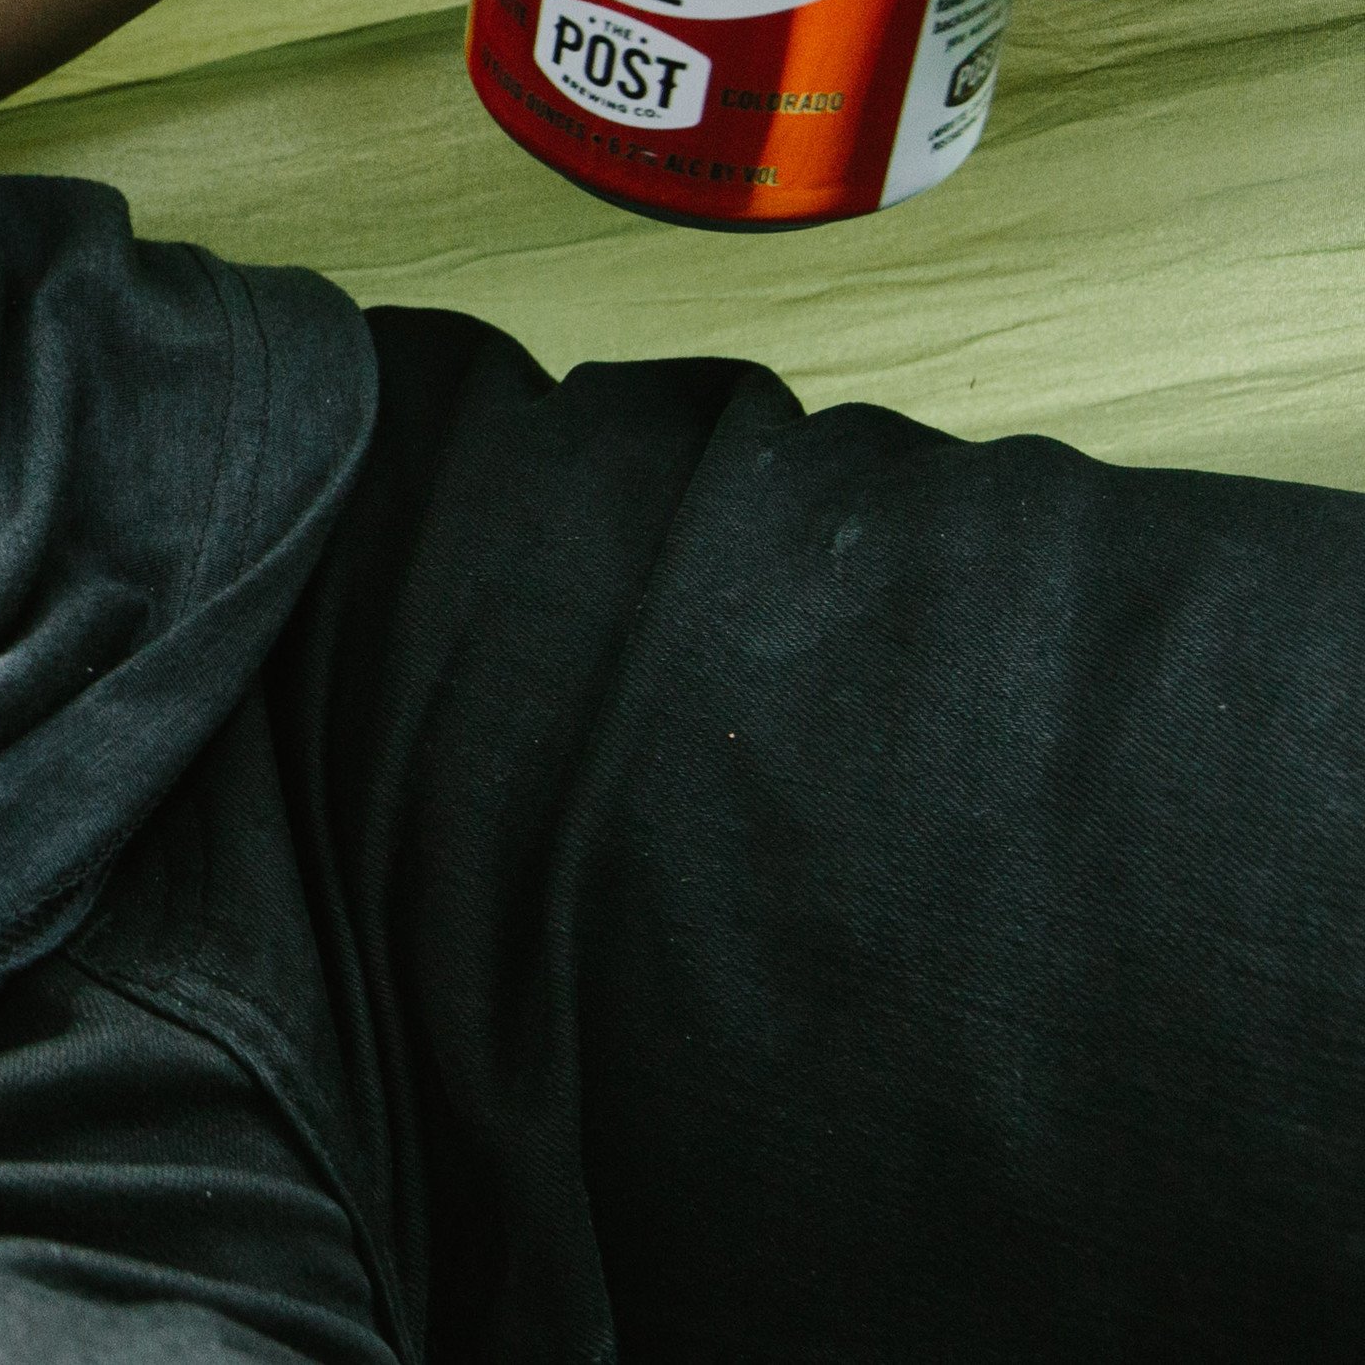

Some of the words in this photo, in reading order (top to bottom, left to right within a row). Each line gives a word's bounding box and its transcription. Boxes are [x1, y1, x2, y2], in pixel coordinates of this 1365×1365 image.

[603, 20, 634, 41] THE
[551, 13, 688, 110] POST
[561, 73, 629, 115] BREWING
[721, 88, 845, 115] COLORADO
[663, 153, 702, 177] ALC
[709, 161, 736, 182] BY
[742, 165, 780, 186] VOL
